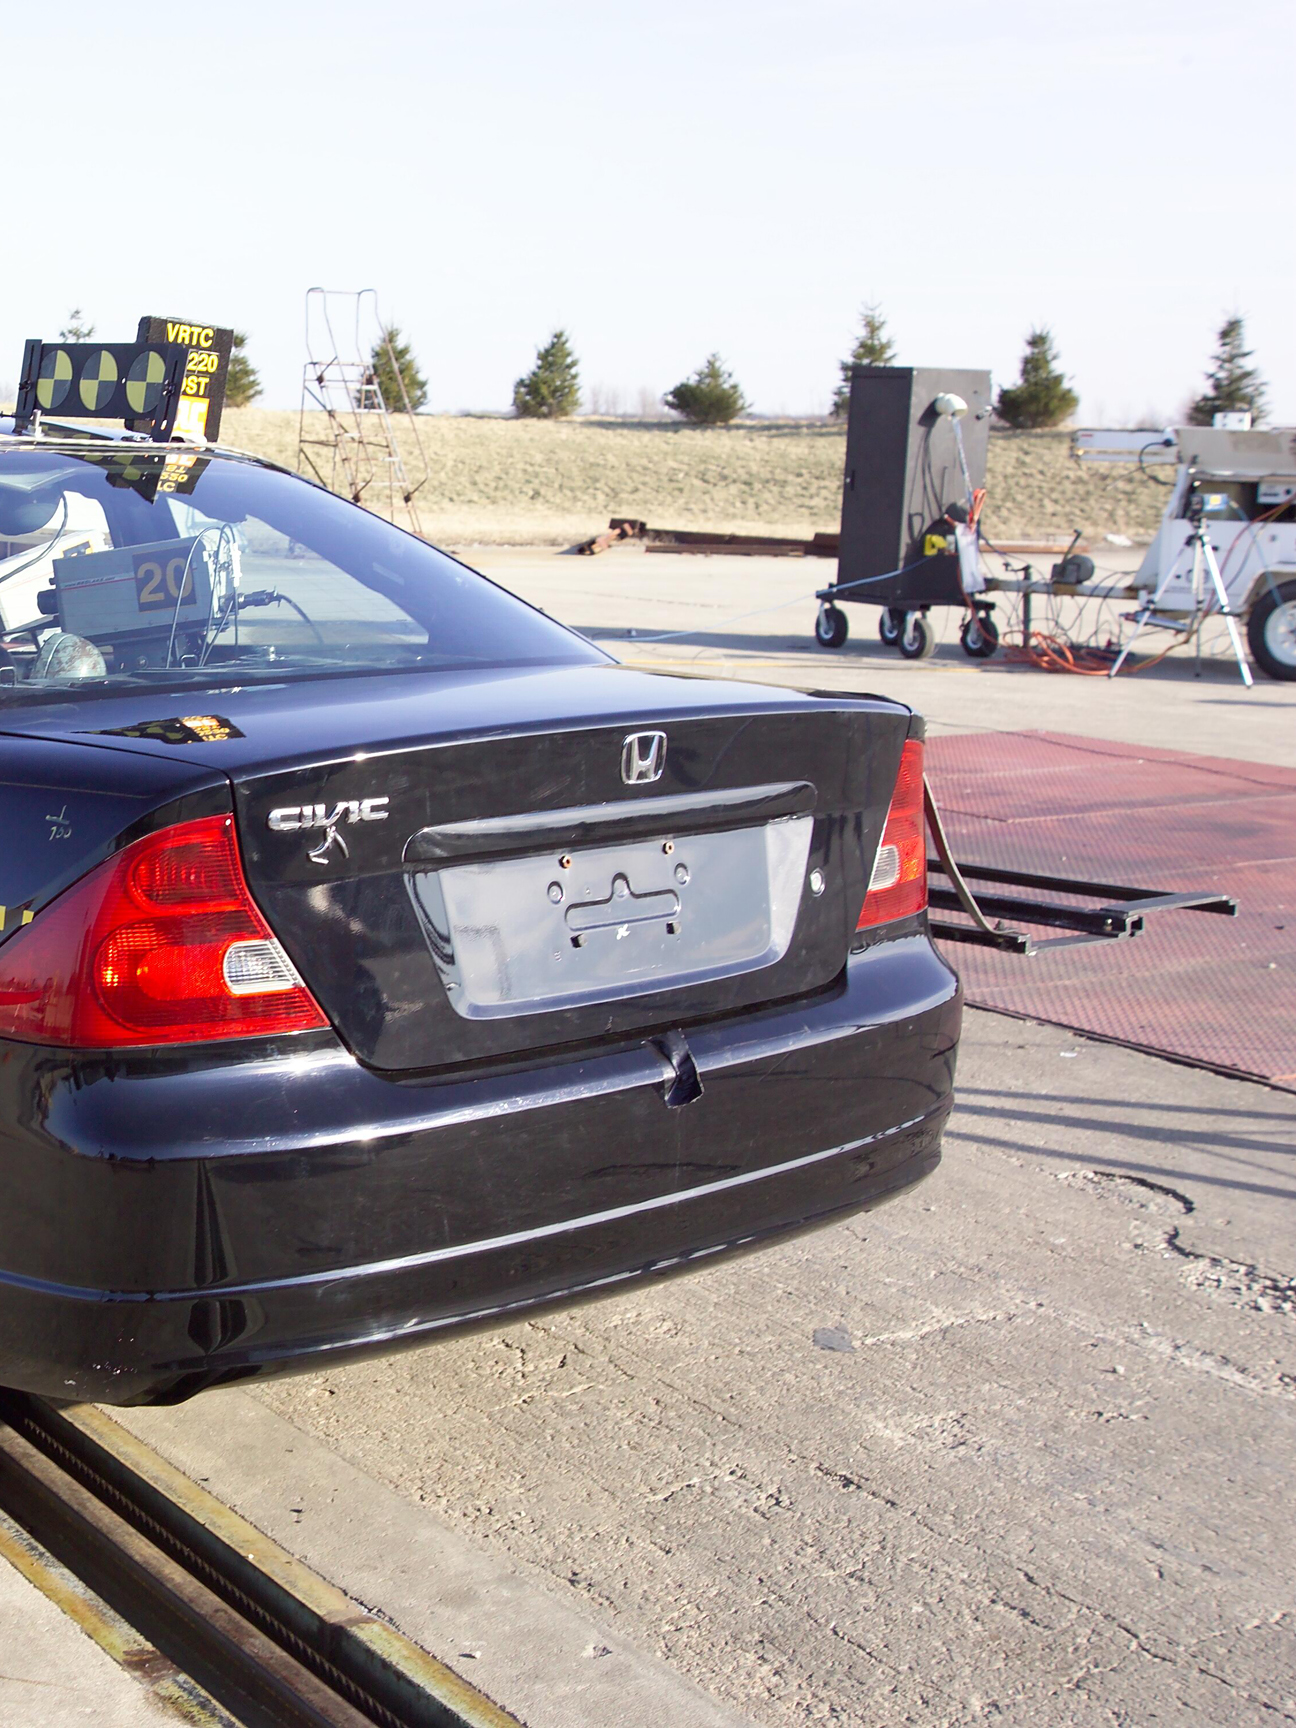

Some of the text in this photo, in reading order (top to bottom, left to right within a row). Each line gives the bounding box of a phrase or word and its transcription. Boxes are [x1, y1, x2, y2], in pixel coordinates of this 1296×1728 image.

[166, 322, 214, 348] VRTC
[186, 352, 218, 373] 220
[137, 557, 193, 603] 20
[267, 796, 390, 832] CIVIC
